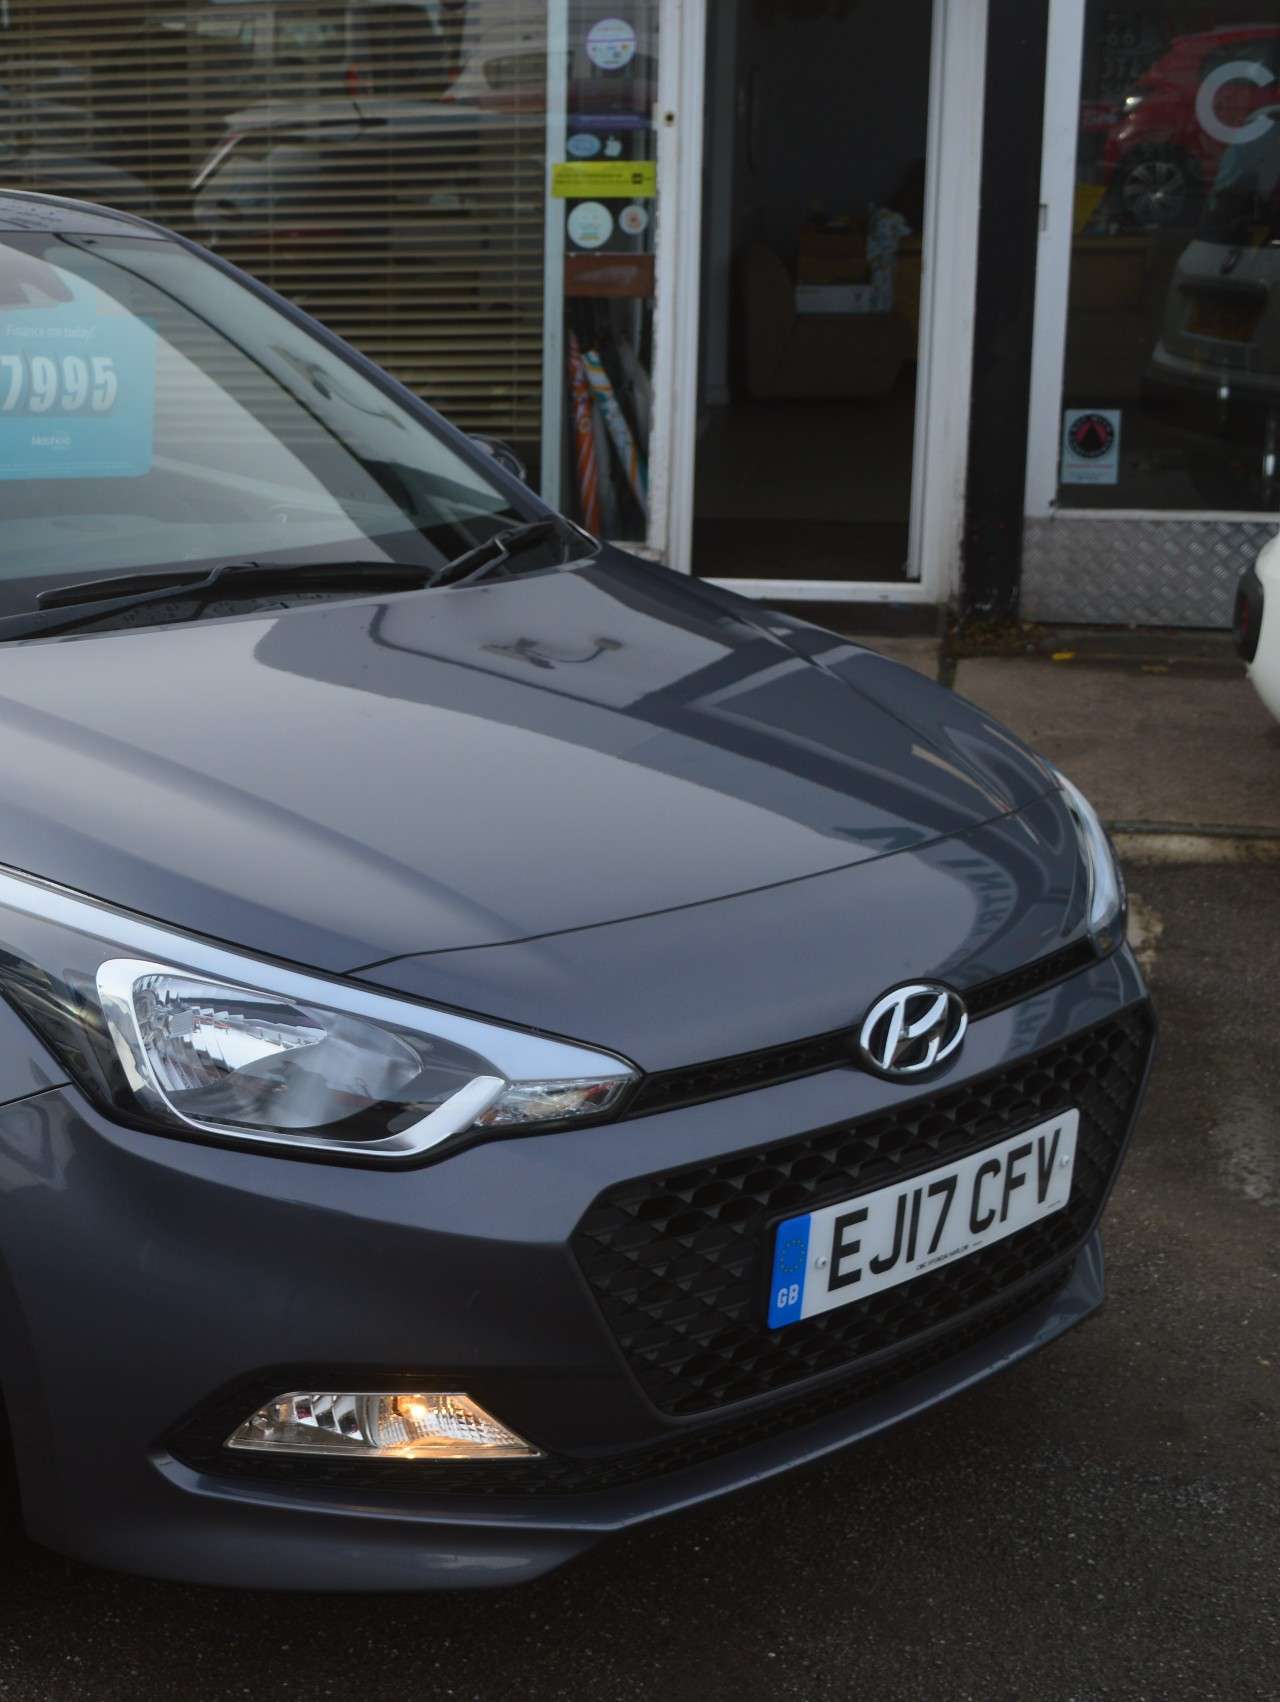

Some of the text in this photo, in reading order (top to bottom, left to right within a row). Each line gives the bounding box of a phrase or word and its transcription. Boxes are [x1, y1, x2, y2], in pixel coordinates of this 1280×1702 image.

[827, 1128, 1062, 1292] EJ17 CFV
[777, 1284, 799, 1308] GB
